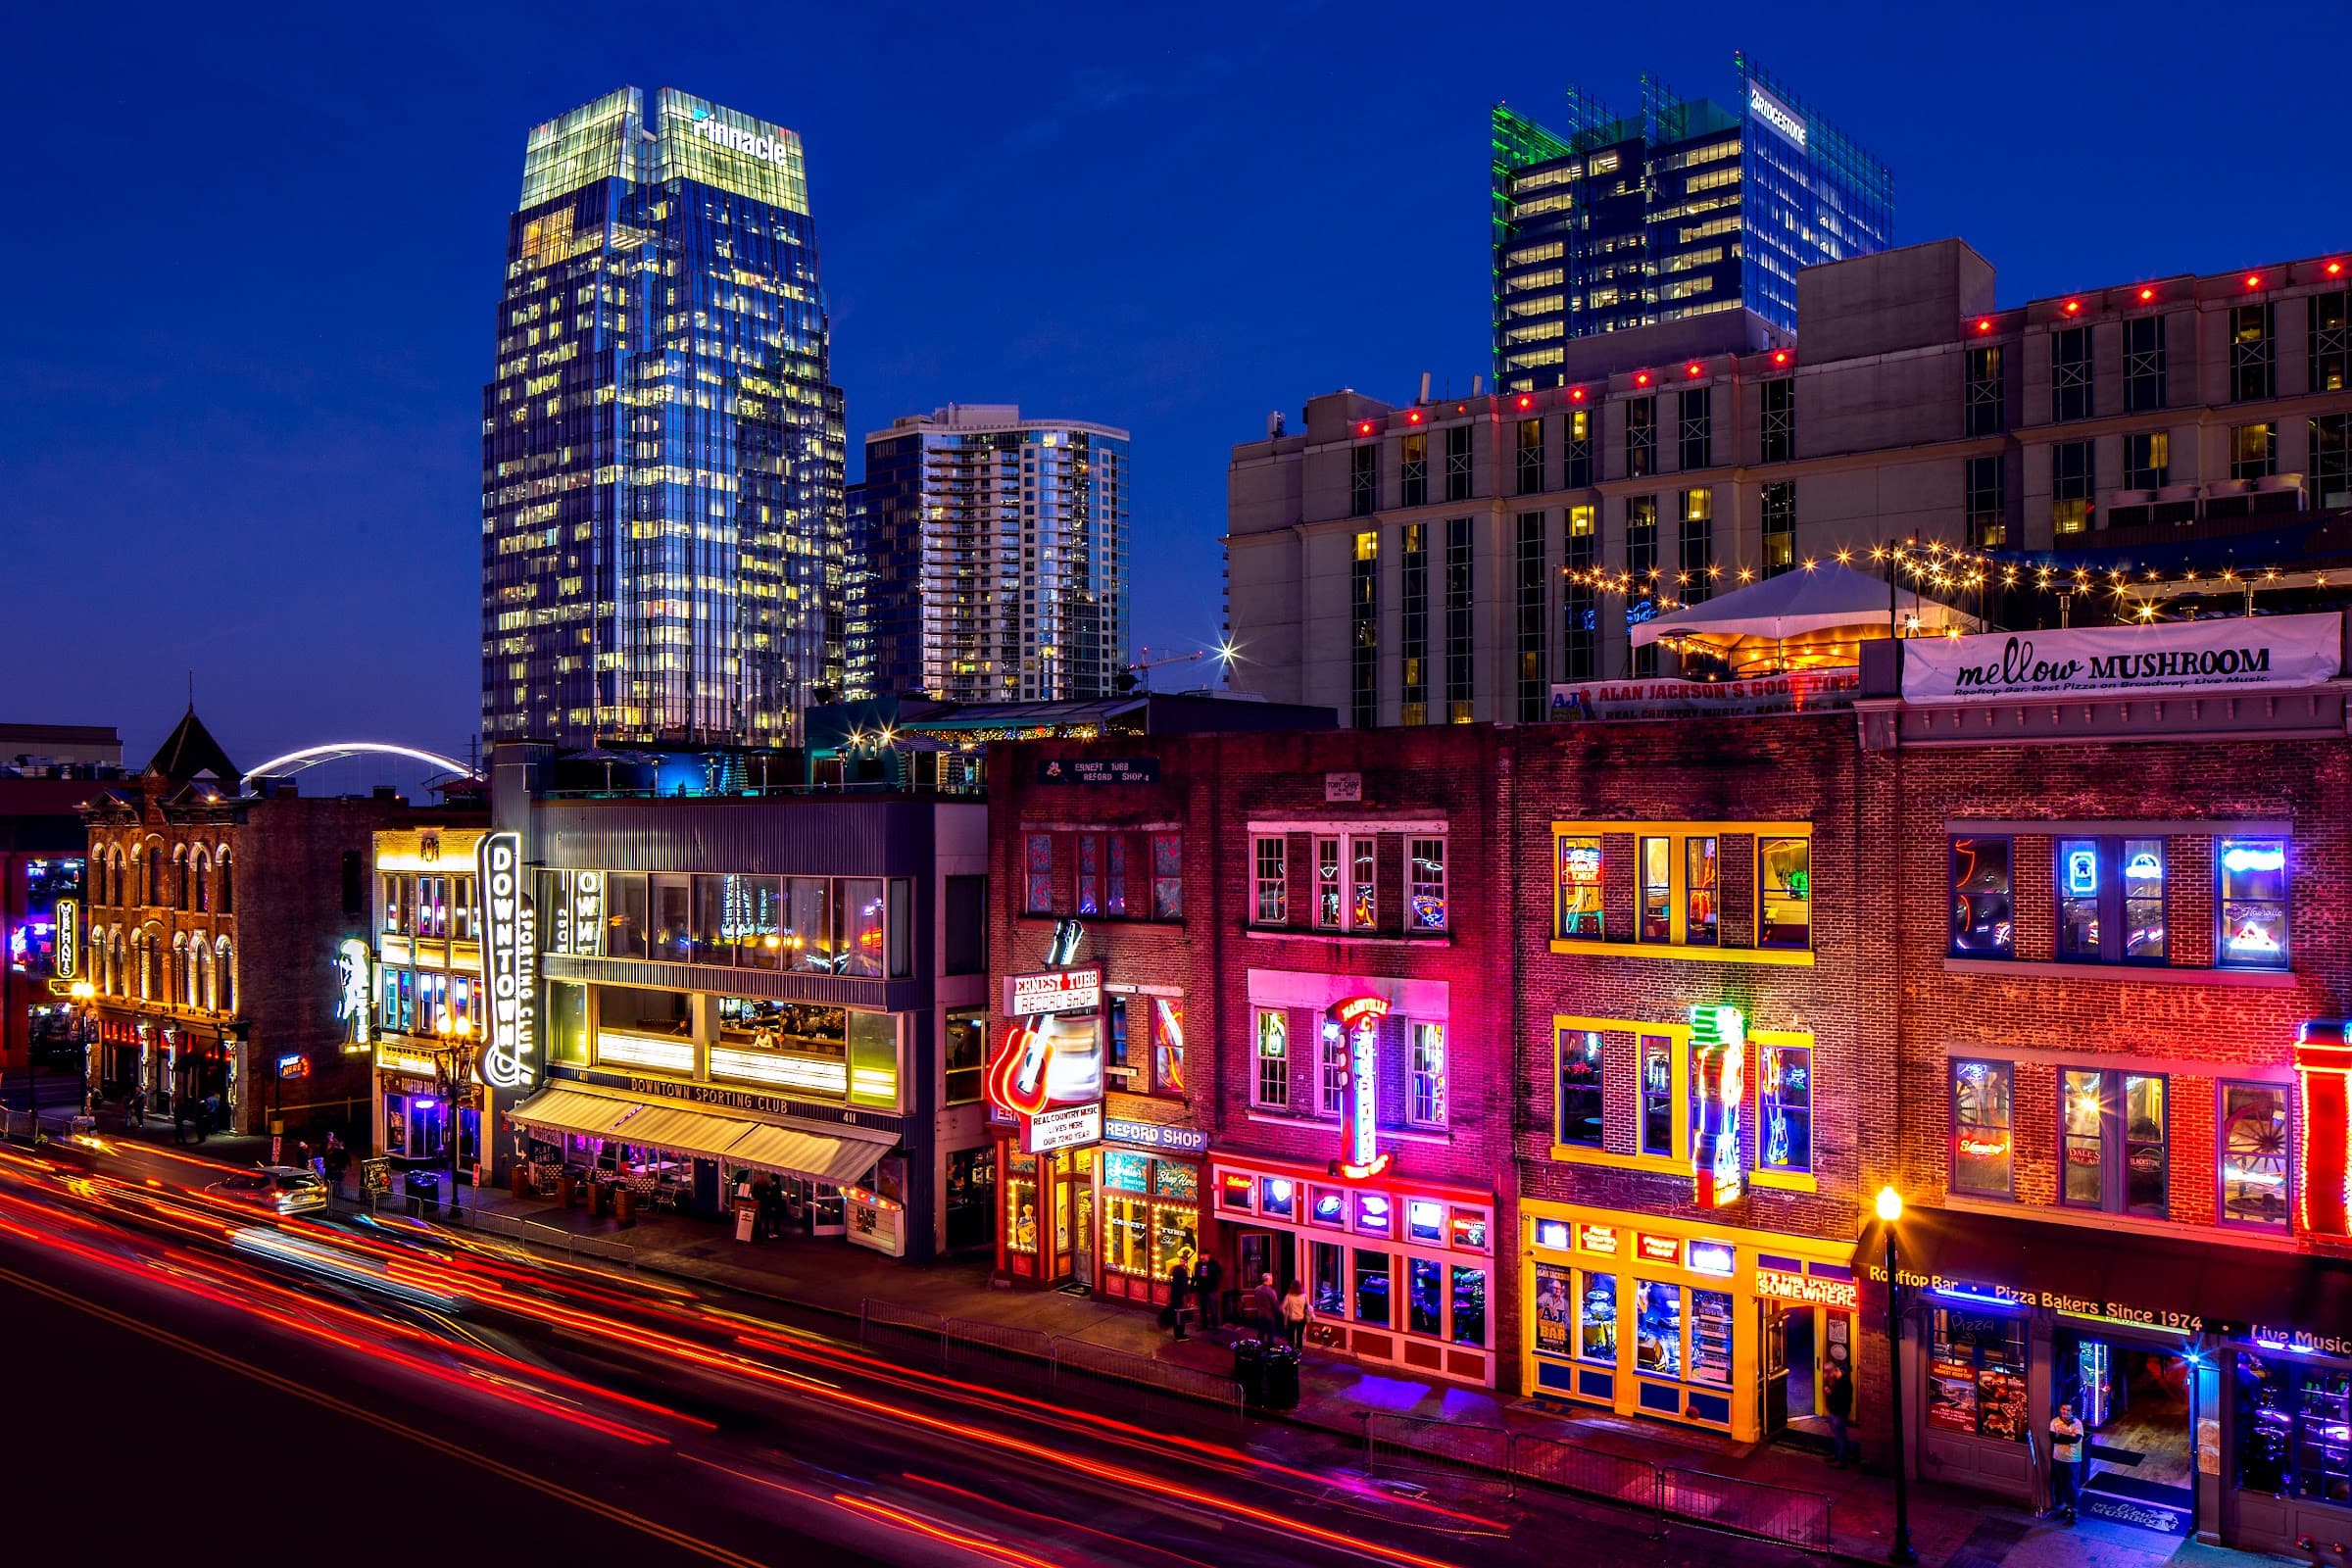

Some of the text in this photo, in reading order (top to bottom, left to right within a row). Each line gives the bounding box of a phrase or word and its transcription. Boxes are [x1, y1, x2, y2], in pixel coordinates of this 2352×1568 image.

[1750, 88, 1806, 146] BRIDGESTONE
[692, 109, 787, 167] Pinnacle
[1956, 637, 2271, 686] mellow MUSHROOM
[1598, 687, 1644, 702] ALAN
[1648, 683, 1745, 700] JACKSON'S
[1954, 688, 2001, 697] Rooftop
[61, 904, 72, 975] MERCHANTS
[493, 847, 515, 1047] DOWNTOWN
[518, 909, 534, 1054] SPORTING CLUB
[1015, 970, 1098, 995] ERNEST TUBB
[1022, 990, 1093, 1012] RECORD SHOP
[1342, 998, 1389, 1021] NASHVILLE
[282, 1061, 302, 1076] HERE
[401, 1076, 423, 1094] ROOFTOP
[632, 1078, 788, 1114] DOWNTOWN SPORTING CLUB
[843, 1112, 857, 1124] 411
[1033, 1115, 1051, 1126] REAL
[1051, 1109, 1080, 1122] COUNTRY
[1043, 1137, 1056, 1147] OUR
[1105, 1121, 1201, 1148] RECORD SHOP
[1157, 1170, 1198, 1187] Shop Here
[1758, 1279, 1857, 1307] SOMEWHERE
[1870, 1265, 1929, 1288] Roftop
[1932, 1275, 1958, 1292] Bar
[1995, 1285, 2037, 1305] Pizza
[2041, 1292, 2099, 1315] Bakers
[2106, 1302, 2154, 1323] Since
[2160, 1310, 2203, 1332] 1974
[2251, 1324, 2289, 1345] Live
[2295, 1331, 2352, 1353] Music
[1540, 1326, 1566, 1341] BAR
